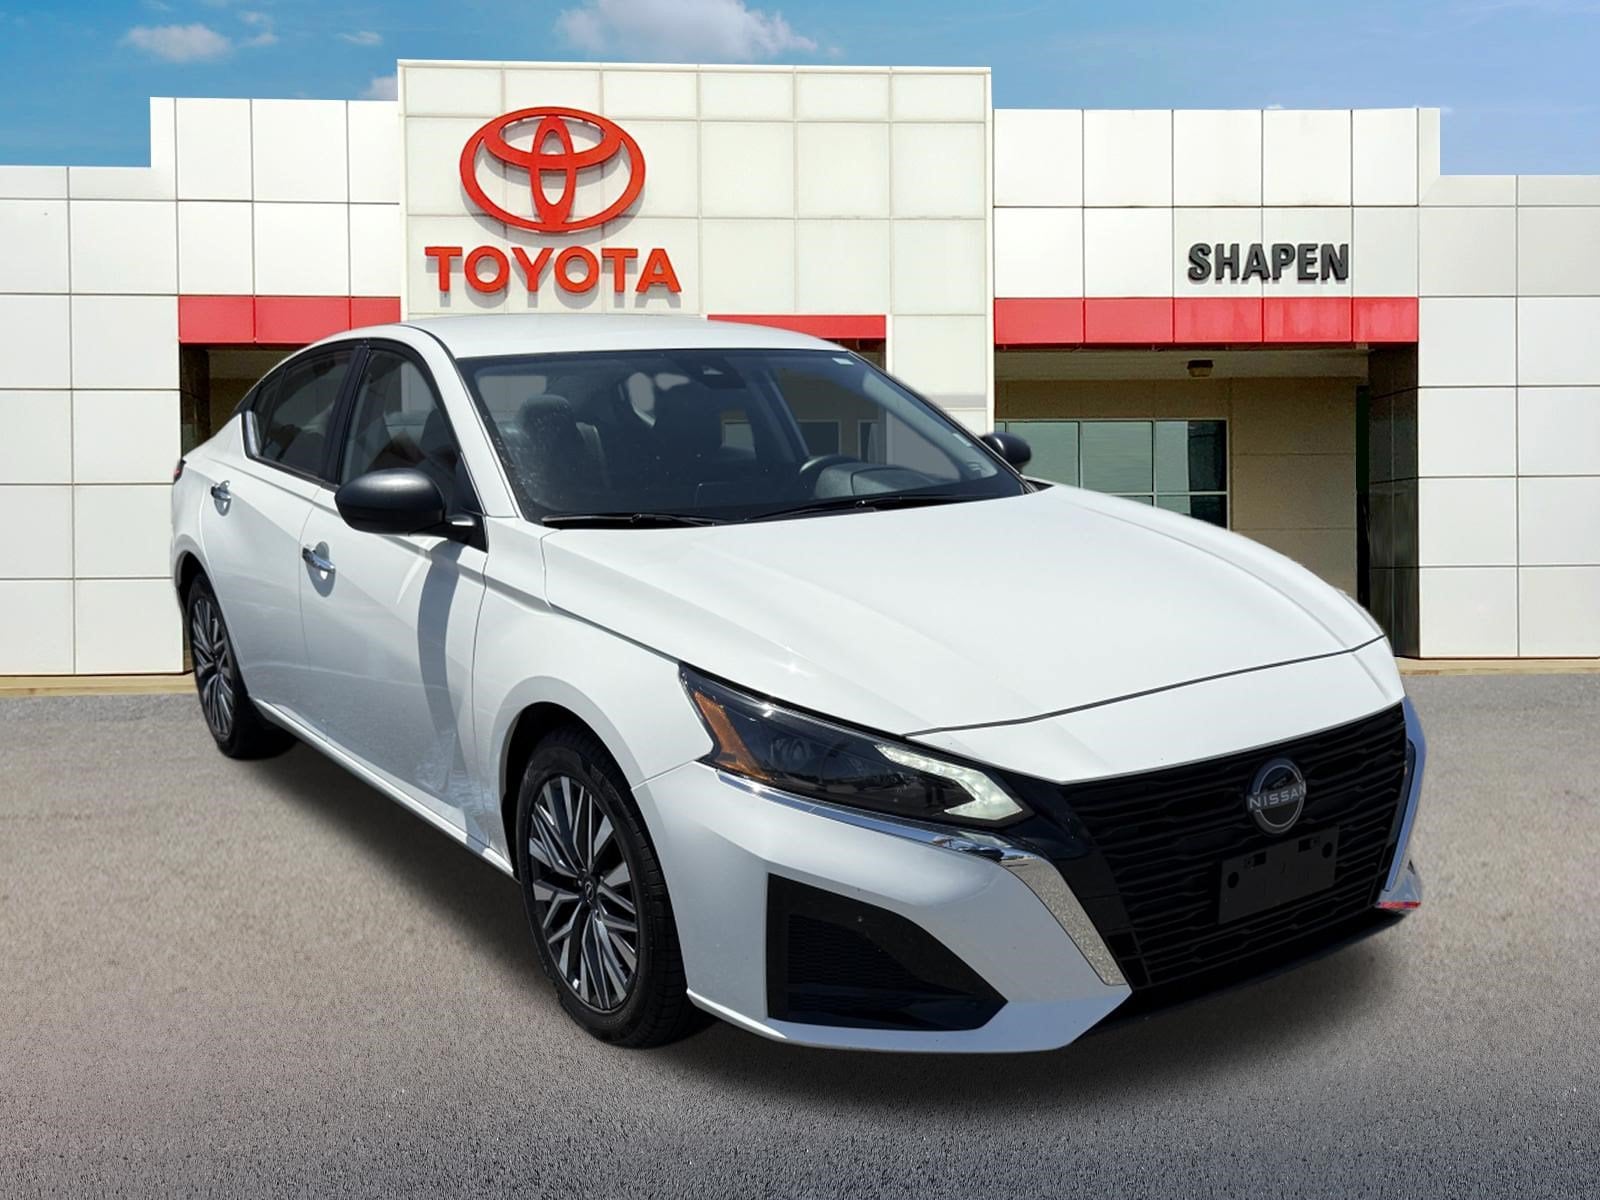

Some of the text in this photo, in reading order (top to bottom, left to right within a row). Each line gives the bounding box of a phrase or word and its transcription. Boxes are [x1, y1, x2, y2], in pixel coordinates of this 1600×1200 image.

[425, 245, 682, 293] TOYOTA
[1188, 243, 1349, 281] SHAPEN
[1249, 780, 1306, 809] NISSAN
